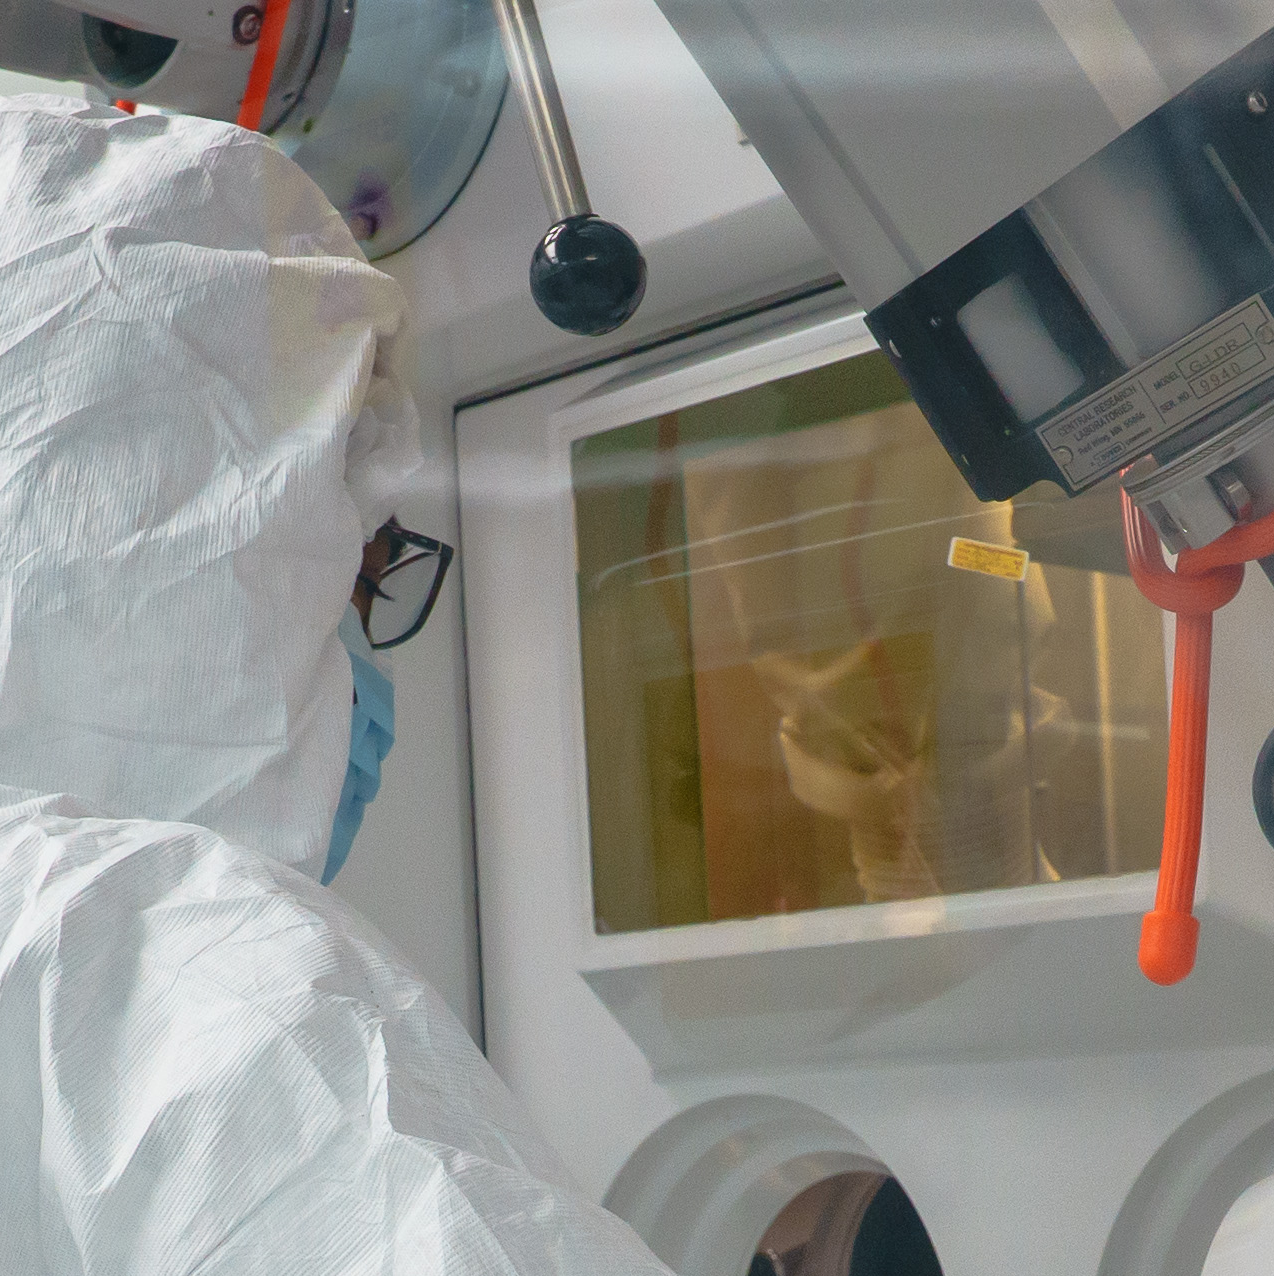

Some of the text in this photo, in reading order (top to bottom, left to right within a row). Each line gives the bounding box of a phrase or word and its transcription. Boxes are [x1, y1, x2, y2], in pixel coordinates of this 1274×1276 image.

[1153, 370, 1180, 390] MODEL
[1199, 361, 1242, 393] 9940
[1058, 385, 1137, 438] CENTRAL RESEARCH
[1074, 401, 1134, 441] LABORATORIES
